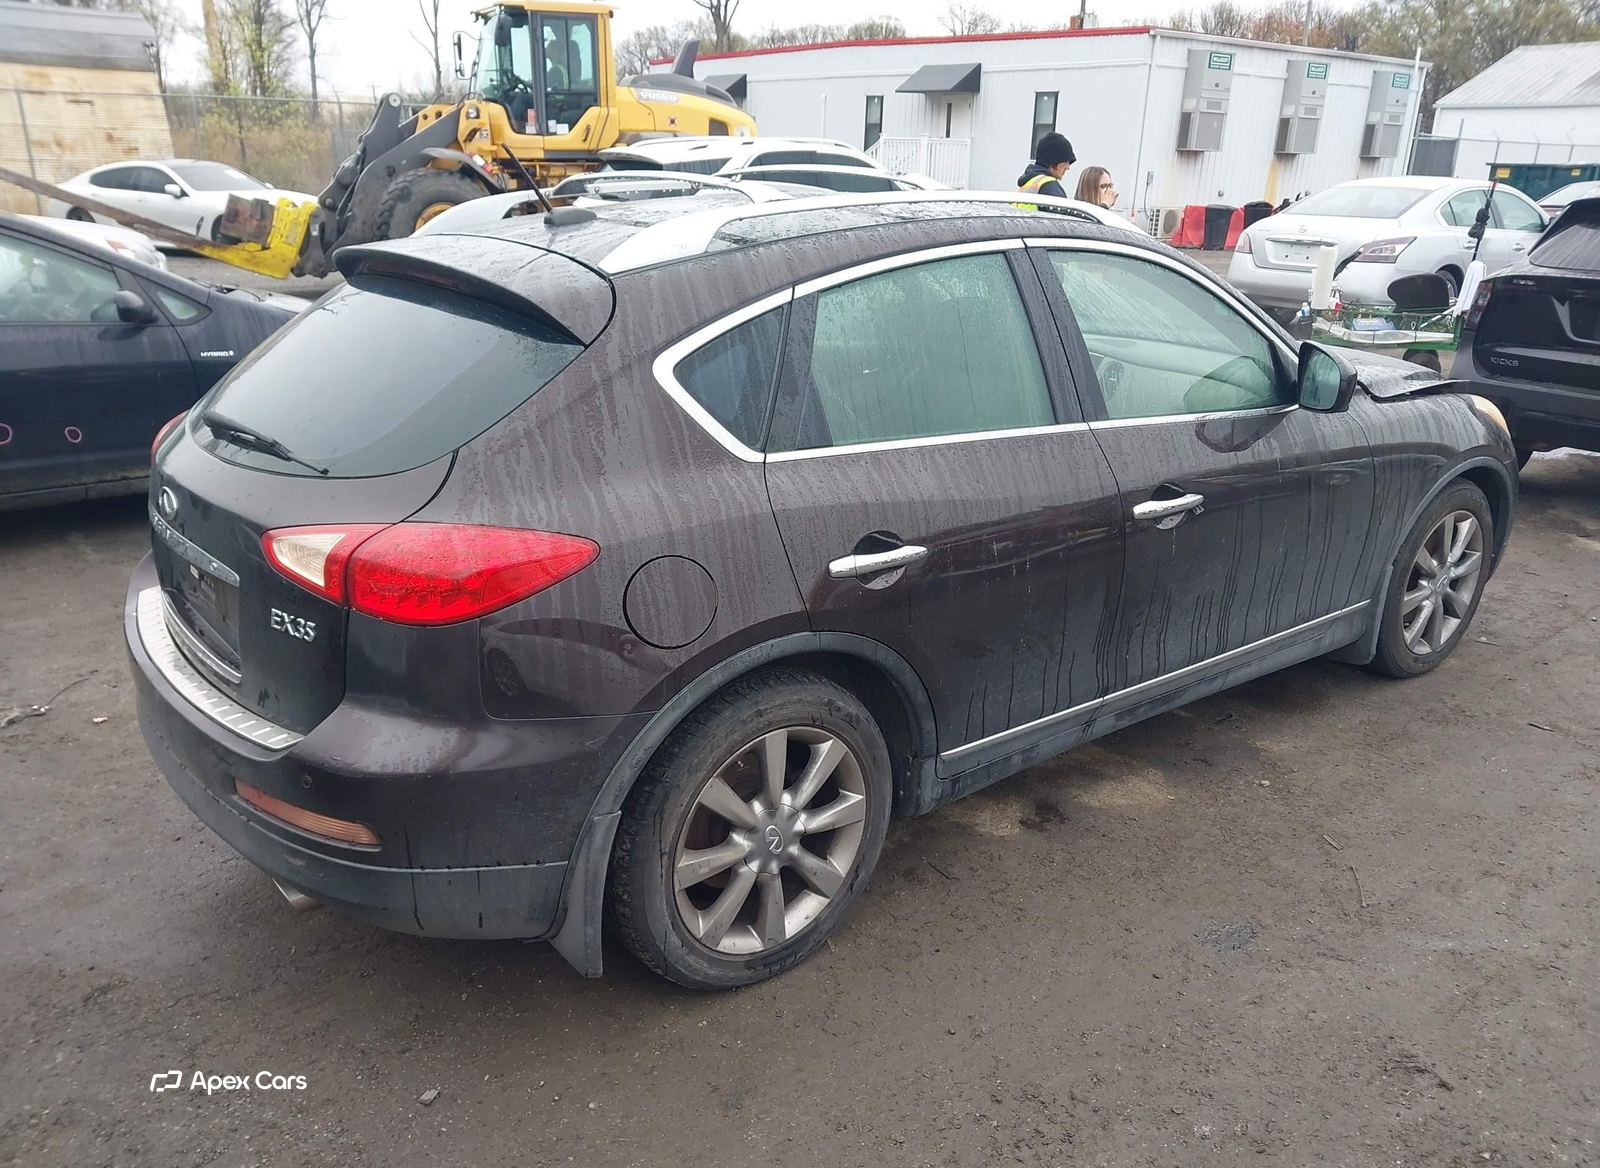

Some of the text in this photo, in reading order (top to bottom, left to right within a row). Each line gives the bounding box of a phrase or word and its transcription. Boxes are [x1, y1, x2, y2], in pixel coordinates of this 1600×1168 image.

[640, 91, 678, 101] VOLVO
[1490, 356, 1519, 367] KICKS
[271, 608, 316, 642] EX35
